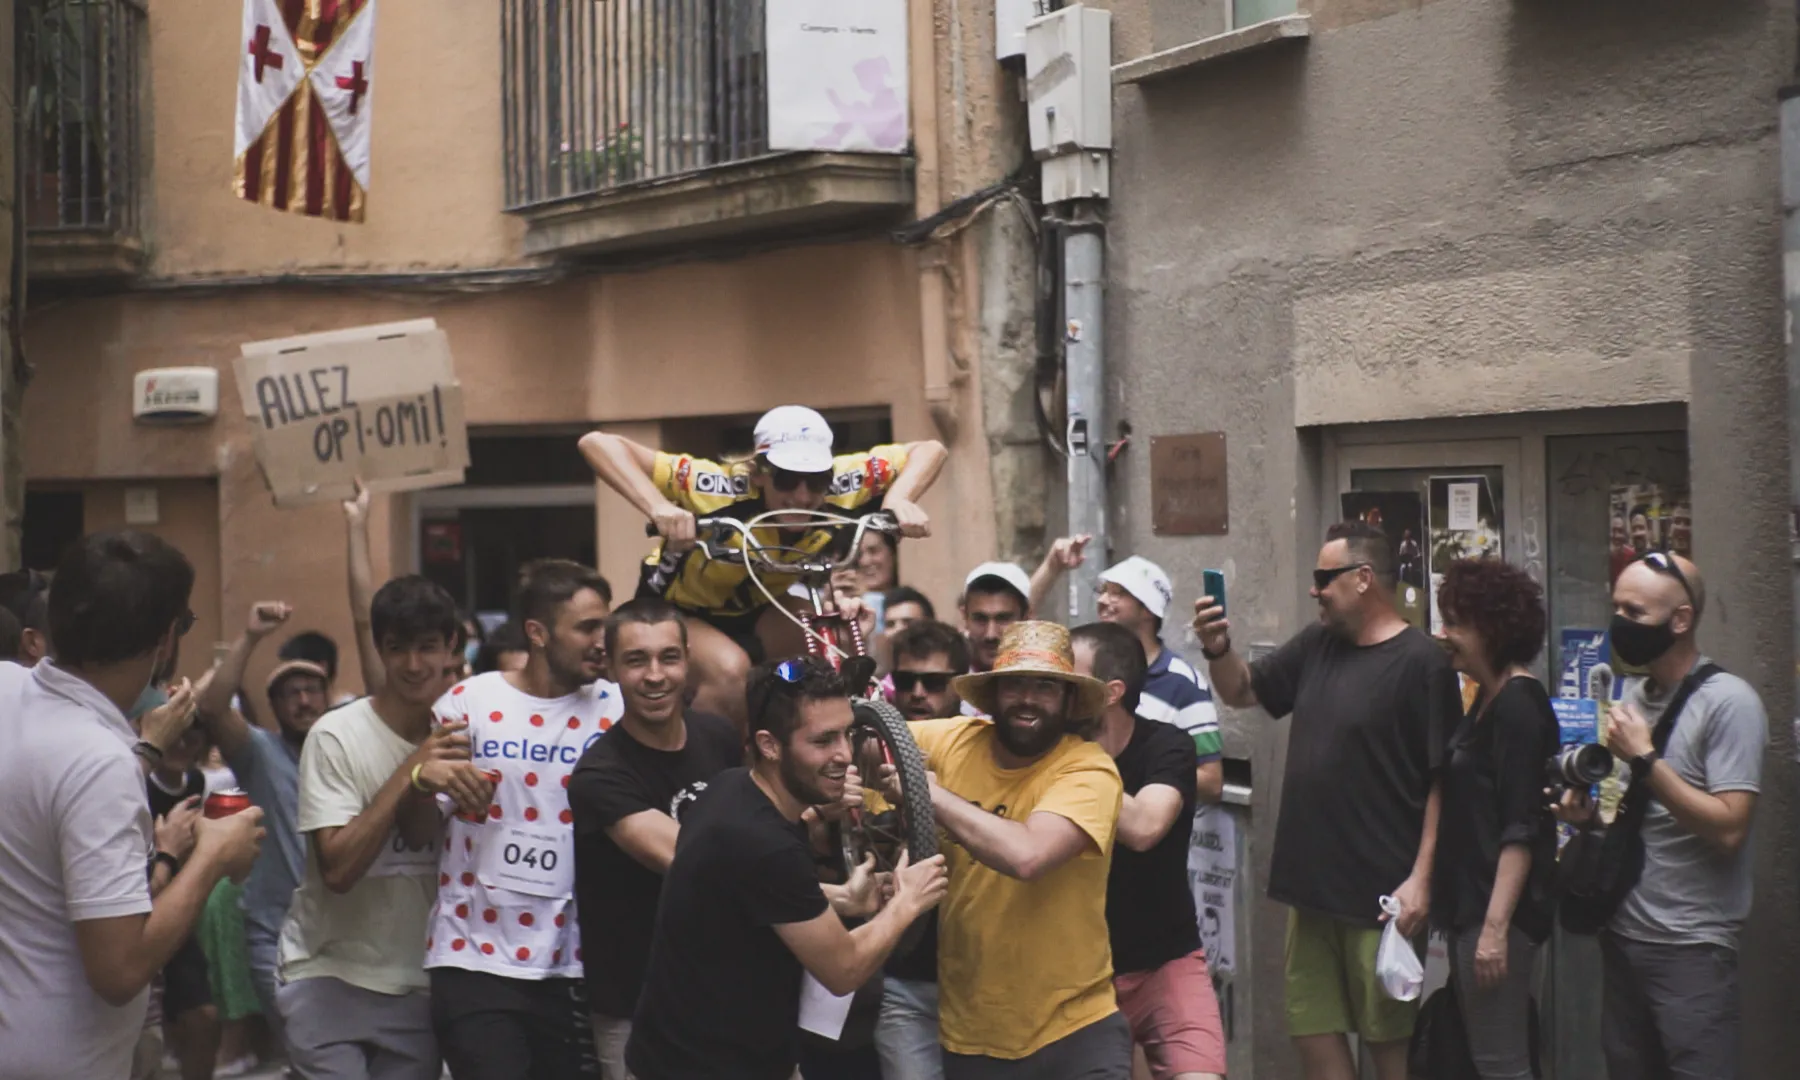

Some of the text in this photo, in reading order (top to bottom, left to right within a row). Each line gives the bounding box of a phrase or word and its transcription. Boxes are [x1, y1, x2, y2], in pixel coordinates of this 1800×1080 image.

[256, 365, 357, 429] ALLEZ
[473, 735, 577, 764] Leclerc
[503, 843, 557, 871] 040
